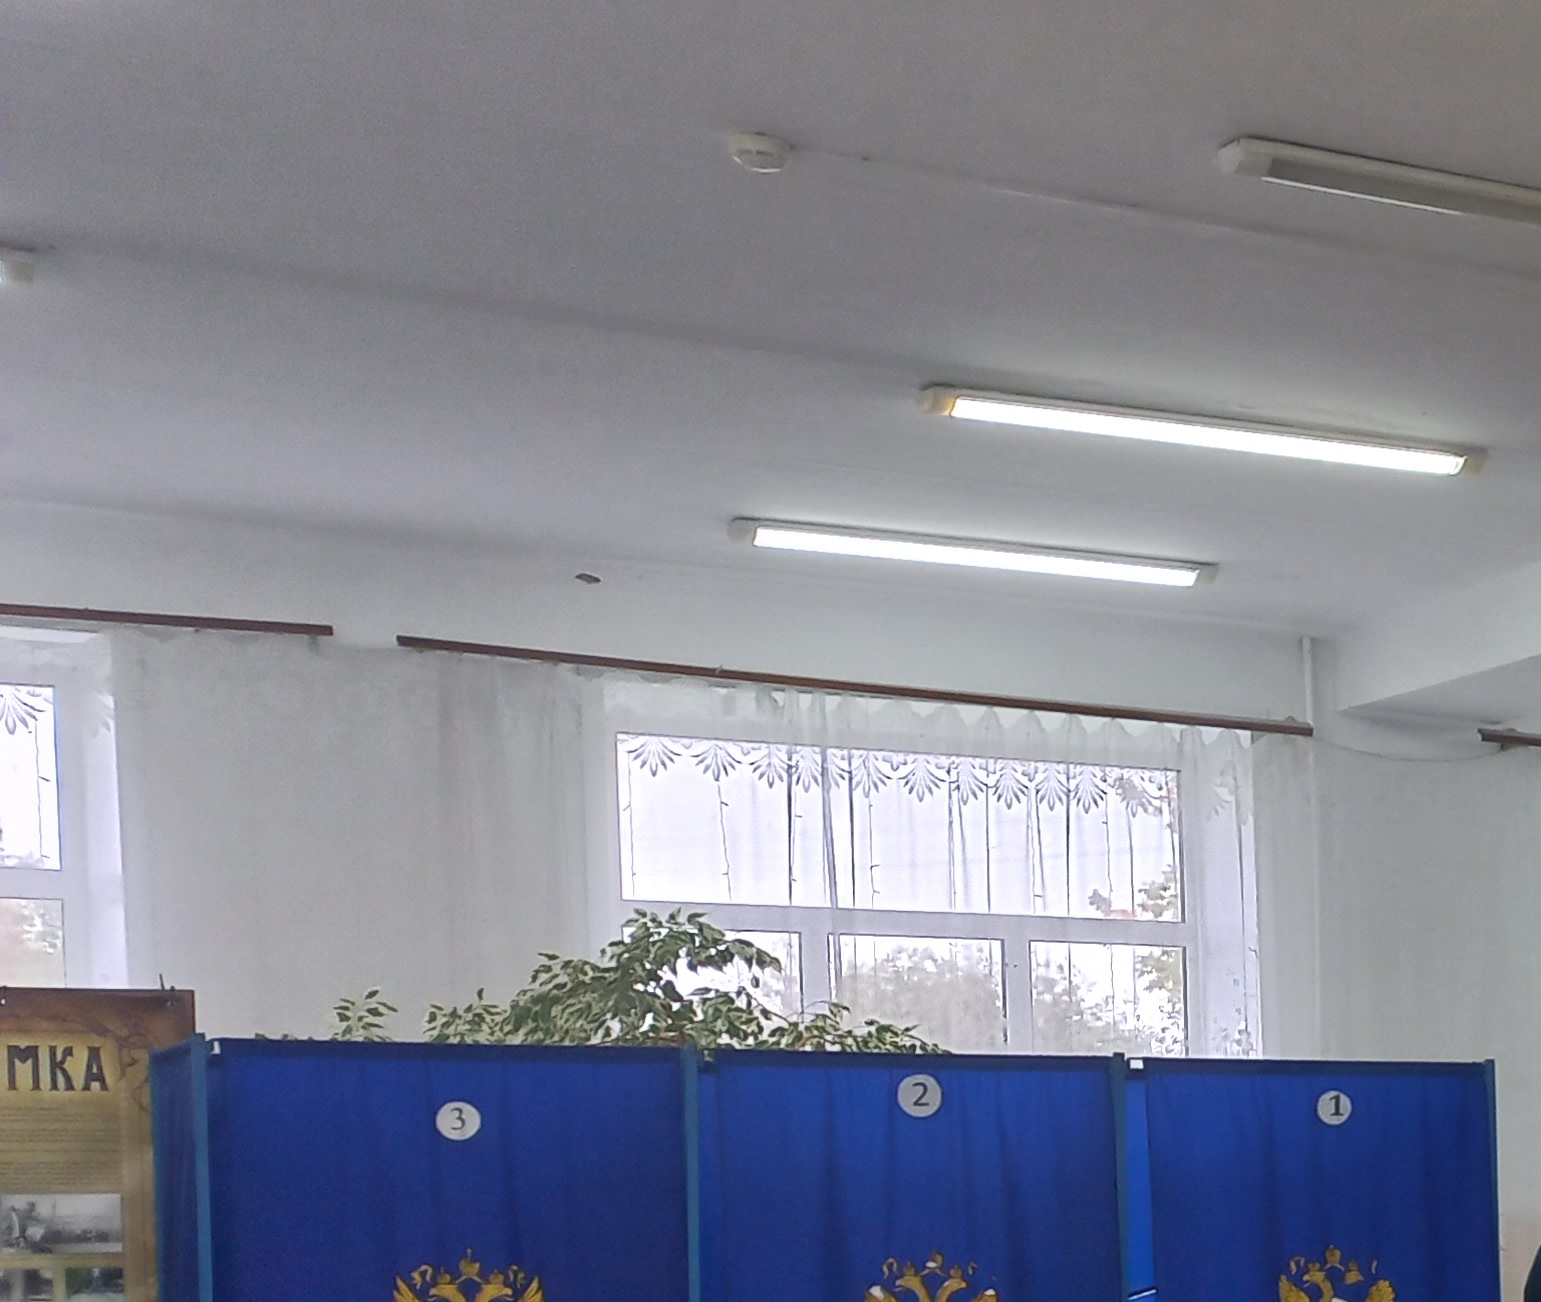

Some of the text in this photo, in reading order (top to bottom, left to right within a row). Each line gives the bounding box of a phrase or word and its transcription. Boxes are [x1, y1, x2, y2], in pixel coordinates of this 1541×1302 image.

[6, 1044, 109, 1092] МКА
[911, 1081, 930, 1107] 2
[1328, 1093, 1345, 1117] 1
[450, 1107, 466, 1131] 3
